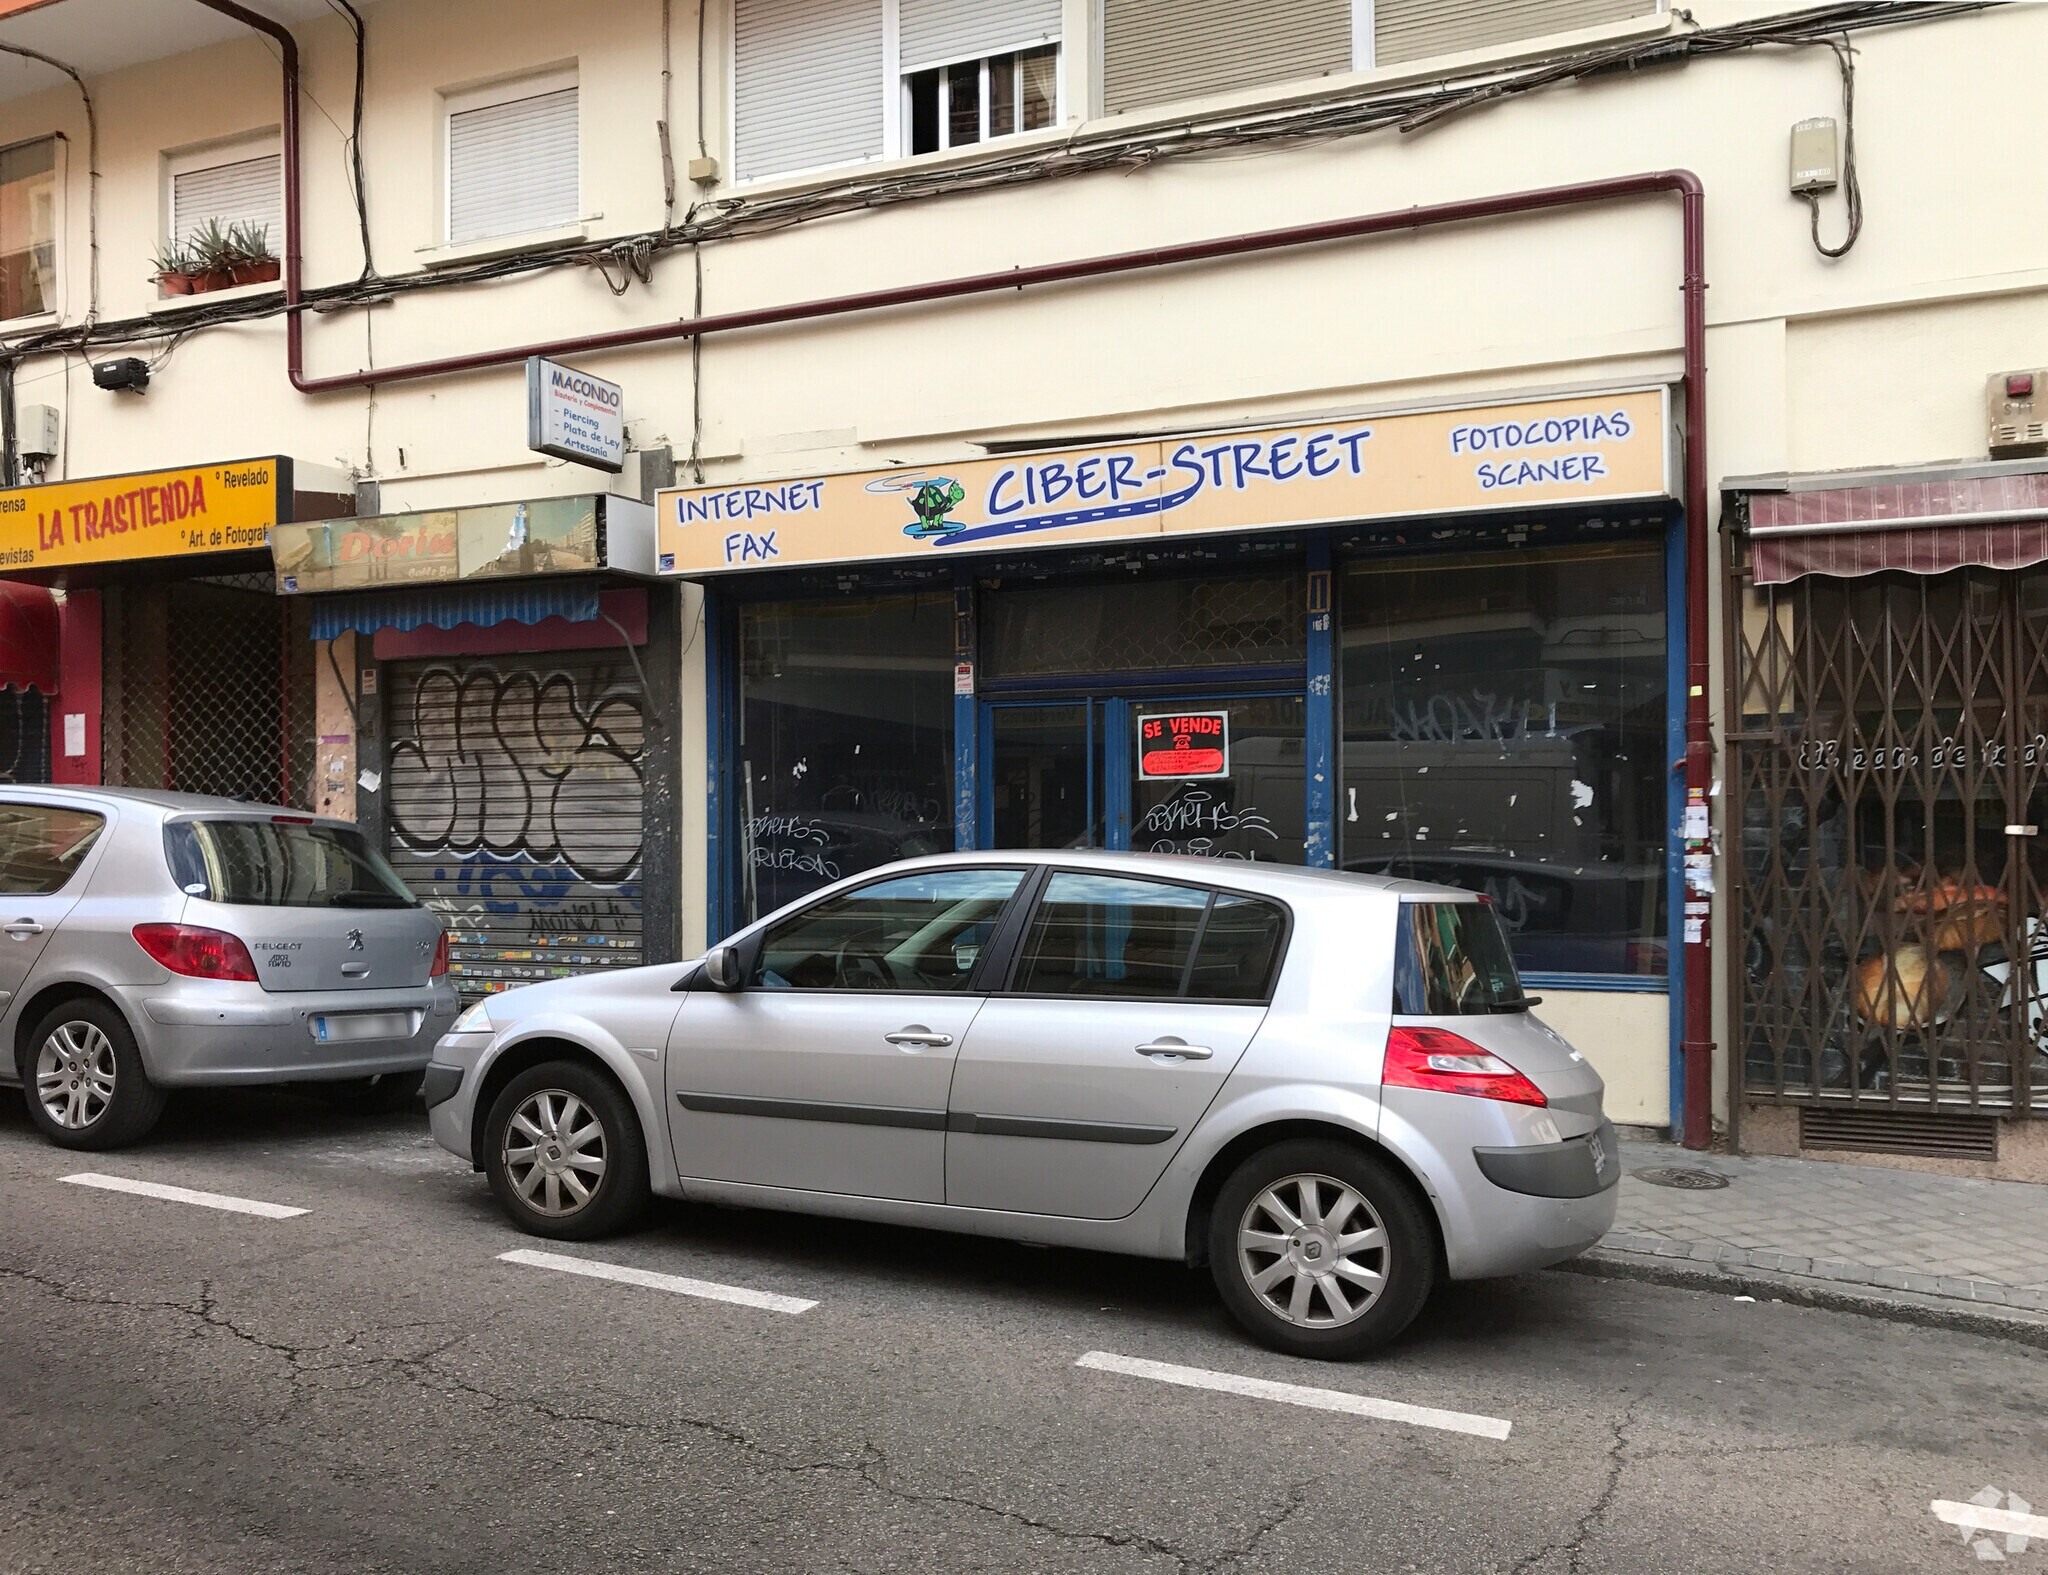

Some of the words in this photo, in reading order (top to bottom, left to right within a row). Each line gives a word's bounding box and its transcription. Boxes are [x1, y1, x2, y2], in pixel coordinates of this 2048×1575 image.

[552, 370, 619, 407] MACONDO
[563, 407, 600, 430] Piercing
[1452, 411, 1631, 453] FOTOCOPIAS
[563, 421, 588, 438] Plata
[590, 432, 602, 442] de
[605, 435, 620, 449] Ley
[224, 468, 269, 489] Revelado
[989, 430, 1371, 514] CIBER-STREET
[1477, 456, 1604, 488] SCANER
[38, 509, 65, 551] LA
[69, 475, 208, 544] TRASTIENDA
[678, 481, 824, 524] INTERNET
[189, 530, 207, 548] Art.
[210, 529, 222, 546] de
[726, 530, 778, 562] FAX
[1144, 720, 1163, 739] SE
[1169, 717, 1223, 737] VENDE
[254, 942, 303, 951] PEUGEOT
